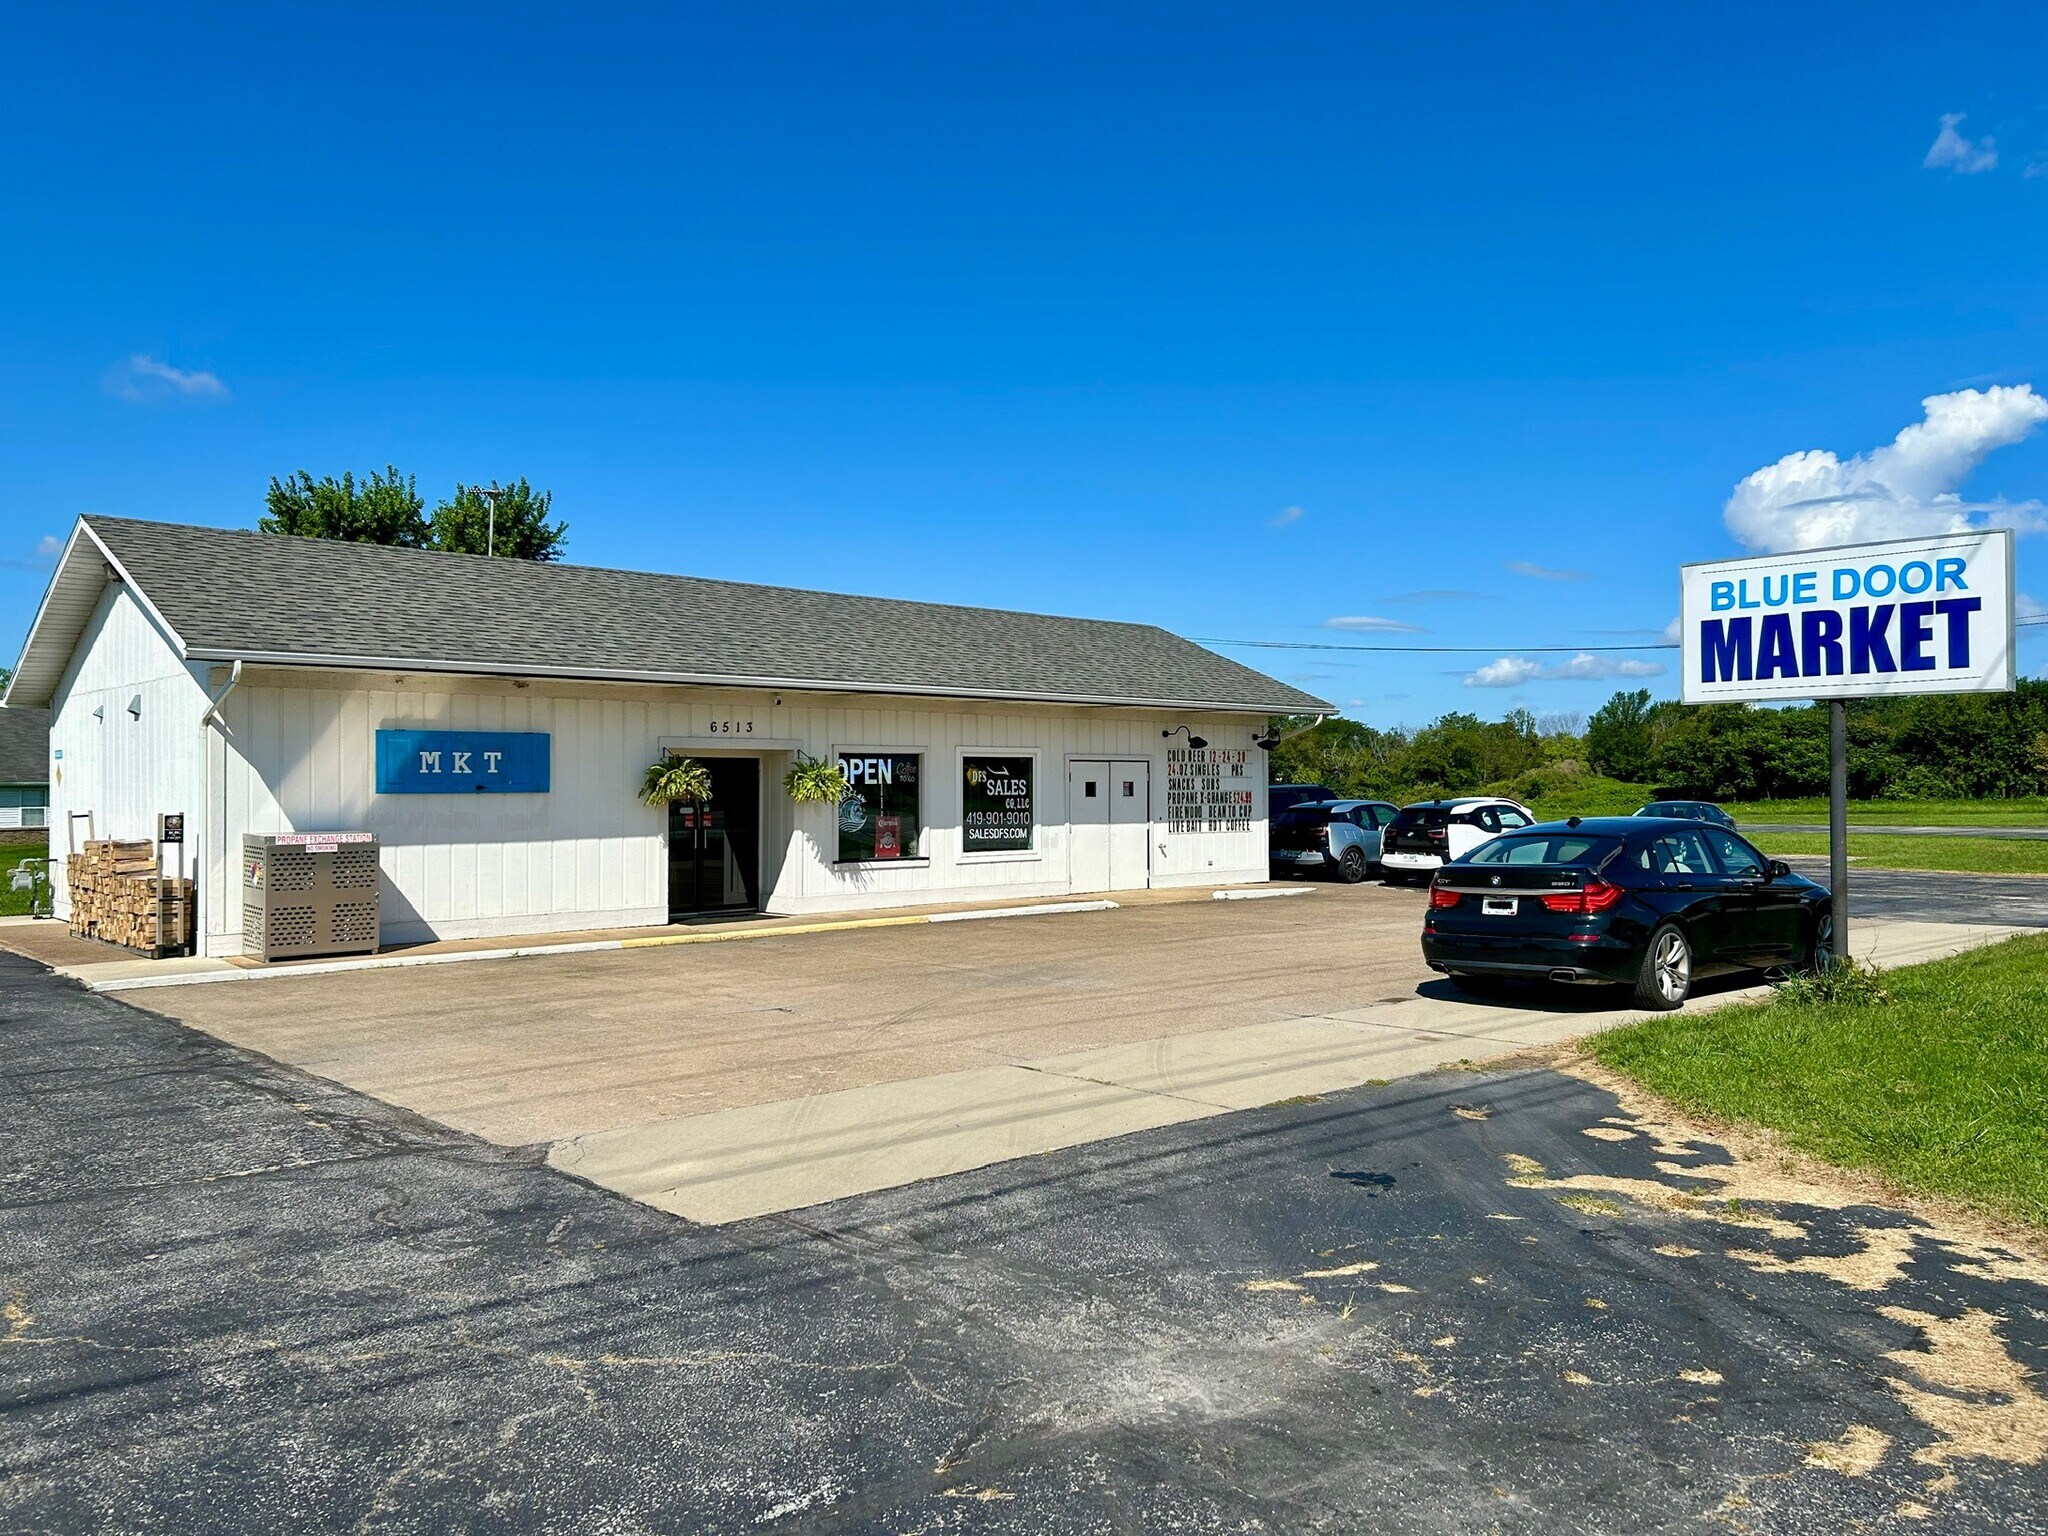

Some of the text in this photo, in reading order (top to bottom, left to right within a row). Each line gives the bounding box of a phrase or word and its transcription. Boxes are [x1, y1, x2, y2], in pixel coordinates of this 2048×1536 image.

[1711, 557, 1969, 611] BLUE DOOR
[1701, 597, 1982, 683] MARKET
[710, 721, 753, 733] 6513
[419, 751, 502, 773] MKT
[1167, 749, 1186, 762] COLD
[1188, 750, 1206, 762] BEER
[838, 758, 892, 785] OPEN
[972, 770, 987, 782] DFS
[1190, 764, 1220, 776] SINGLES
[1231, 764, 1244, 776] PKS
[986, 779, 1027, 796] SALES
[1168, 778, 1220, 790] SNACKS SUBS
[1168, 792, 1198, 805] PROPANE
[1200, 791, 1232, 804] X-CHANGE
[966, 811, 1031, 825] 419-901-9010
[1168, 805, 1252, 819] FIREWOOD BEAN TO CUP
[1168, 819, 1250, 833] LIVE BAIT HOT COFFEE
[277, 834, 371, 845] PROPANE EXCHANGE STATION
[968, 828, 1028, 840] SALESDFS.COM
